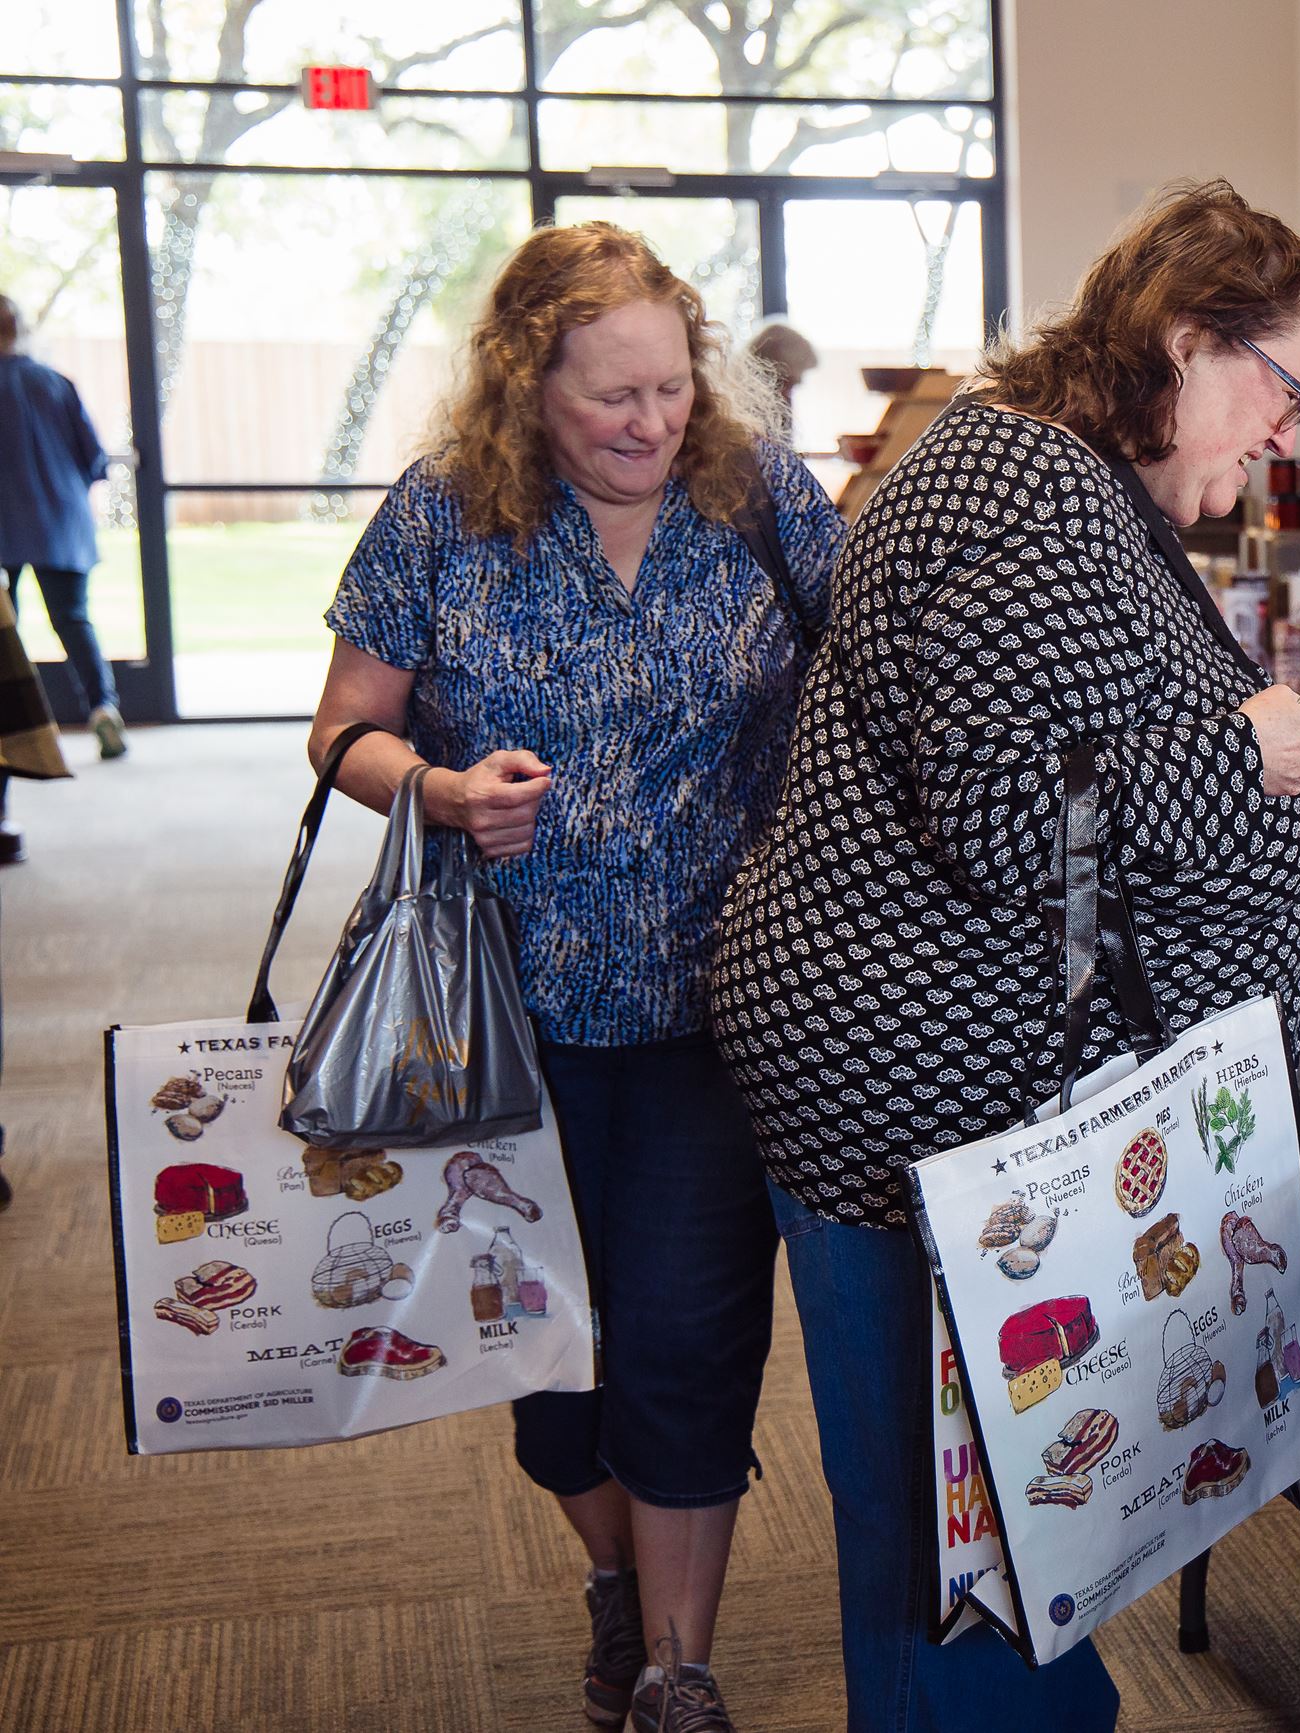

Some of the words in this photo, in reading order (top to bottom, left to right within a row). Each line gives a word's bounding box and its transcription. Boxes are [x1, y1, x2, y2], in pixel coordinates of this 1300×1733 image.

[195, 1037, 261, 1053] TEXAS
[268, 1035, 295, 1049] FA
[204, 1067, 263, 1082] Pecans
[1215, 1054, 1260, 1085] HERBS
[1234, 1064, 1269, 1092] (Hierbas)
[217, 1081, 256, 1092] (Nueces)
[1010, 1129, 1080, 1166] TEXAS
[1079, 1086, 1151, 1139] FARMERS
[1150, 1046, 1209, 1095] MARKETS
[1155, 1106, 1171, 1128] PIES
[1161, 1117, 1180, 1140] (Tartas)
[1025, 1164, 1091, 1201] Pecans
[1045, 1181, 1086, 1209] (Nueces)
[1224, 1174, 1265, 1208] Chicken
[1241, 1191, 1263, 1213] (Pollo)
[374, 1218, 413, 1238] EGGS
[384, 1231, 422, 1248] (Huevos)
[244, 1235, 283, 1248] (Queso)
[1122, 1284, 1140, 1306] (Pan)
[230, 1305, 282, 1319] PORK
[1193, 1306, 1219, 1337] EGGS
[230, 1319, 267, 1332] (Cerdo)
[479, 1321, 519, 1340] MILK
[1202, 1319, 1227, 1346] (Huevos)
[246, 1338, 344, 1363] MEAT
[479, 1340, 514, 1354] (Leche)
[300, 1354, 337, 1370] (Carne)
[1101, 1356, 1132, 1384] (Queso)
[184, 1401, 260, 1417] COMMISSIONER
[263, 1398, 279, 1408] SID
[281, 1395, 314, 1405] MILLER
[207, 1393, 252, 1406] DEPARTMENT
[1263, 1398, 1290, 1428] MILK
[1265, 1420, 1287, 1445] (Leche)
[1100, 1441, 1142, 1475] PORK
[1103, 1462, 1133, 1490] (Cerdo)
[1120, 1462, 1186, 1521] MEAT
[1158, 1483, 1182, 1510] (Carne)
[1074, 1583, 1094, 1600] TEXAS
[1095, 1560, 1127, 1588] DEPARTMENT
[1127, 1553, 1134, 1563] OF
[1134, 1529, 1167, 1556] AGRICULTURE
[1076, 1567, 1130, 1611] COMMISSIONER
[1131, 1557, 1142, 1570] SID
[1142, 1539, 1166, 1561] MILLER
